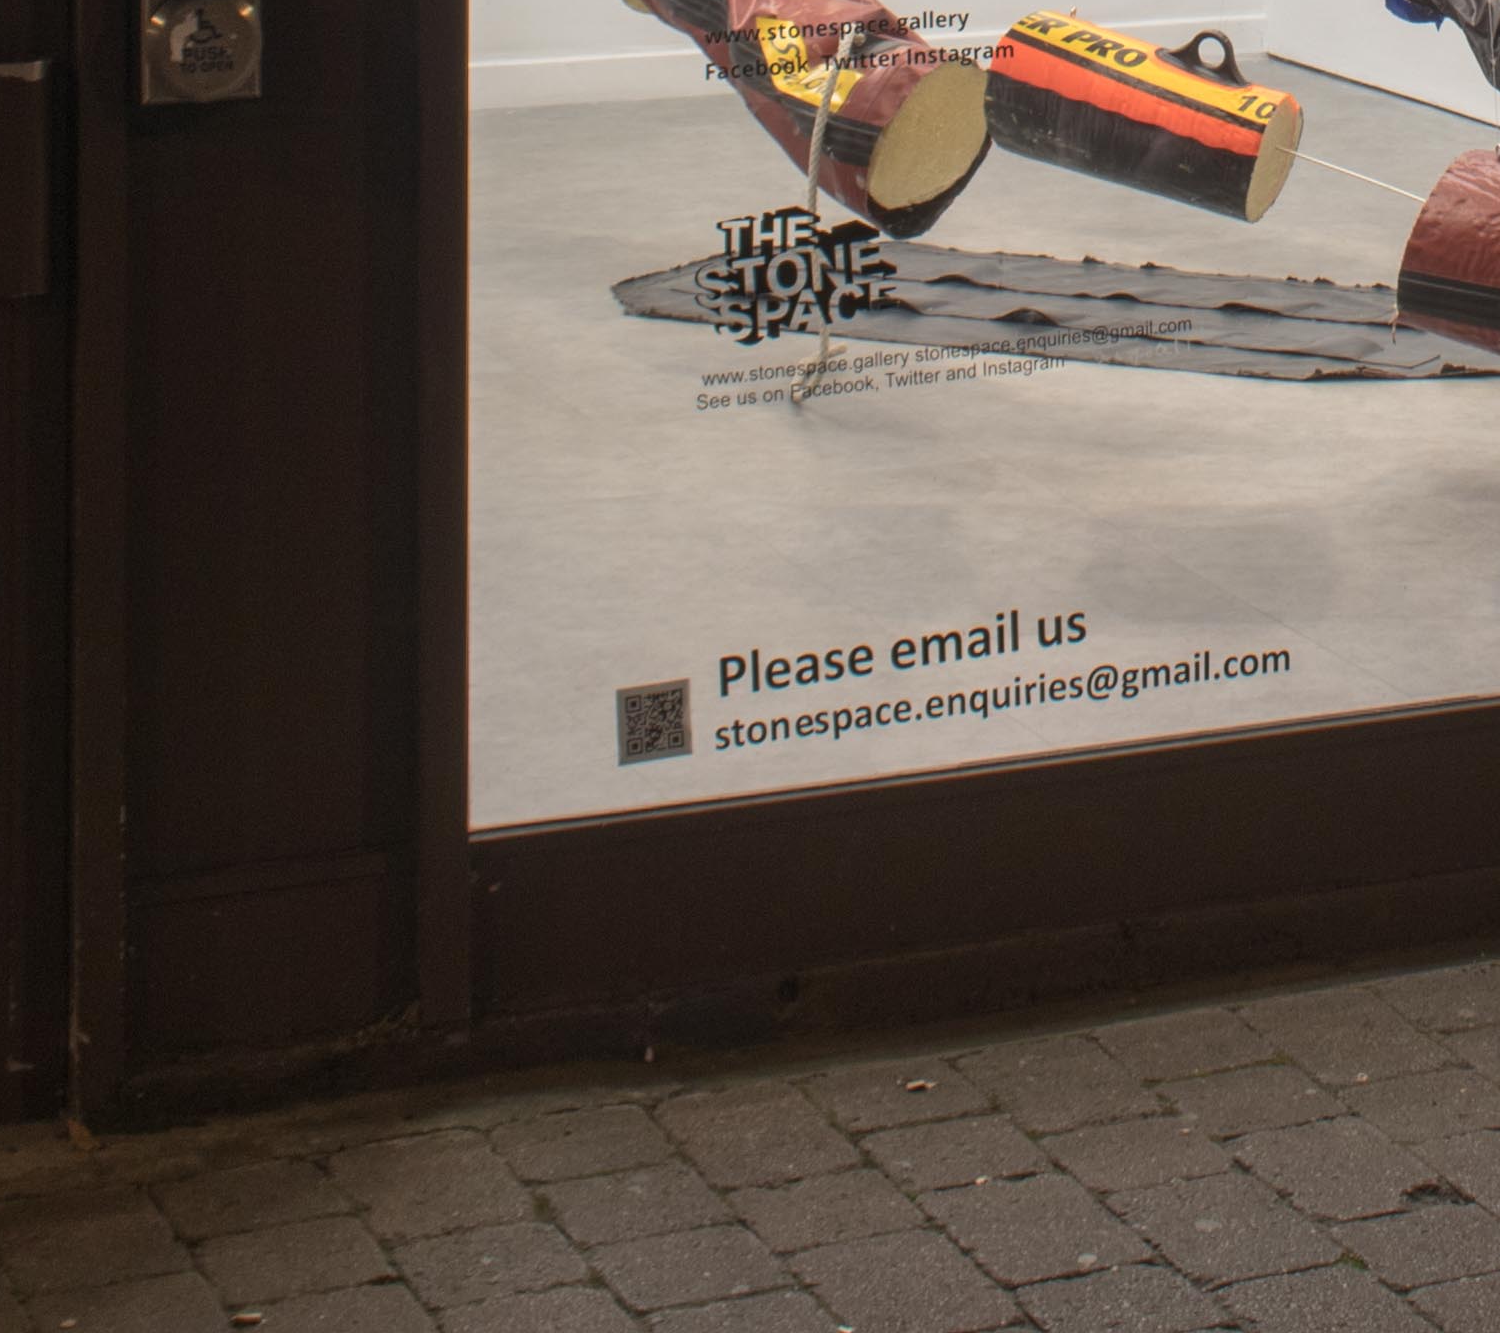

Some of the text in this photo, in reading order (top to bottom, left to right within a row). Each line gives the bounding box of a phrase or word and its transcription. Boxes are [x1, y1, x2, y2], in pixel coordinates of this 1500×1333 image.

[704, 10, 970, 45] www.stonespace.gallery
[1061, 29, 1149, 68] PRO
[704, 55, 809, 81] Facebook
[820, 49, 900, 72] Twitter
[906, 41, 1015, 67] Instagram
[717, 205, 821, 259] THE
[695, 239, 888, 309] STONE
[708, 282, 899, 343] SPACE
[701, 349, 910, 387] www.stonespace.gallery
[914, 317, 1193, 364] stonespace.enquiries@gmail.com
[696, 354, 1066, 410] See us on Facebook, Twitter and Instagram
[718, 608, 1088, 698] Please email us
[714, 643, 1292, 751] stonespace.enquiries@gmail.com
